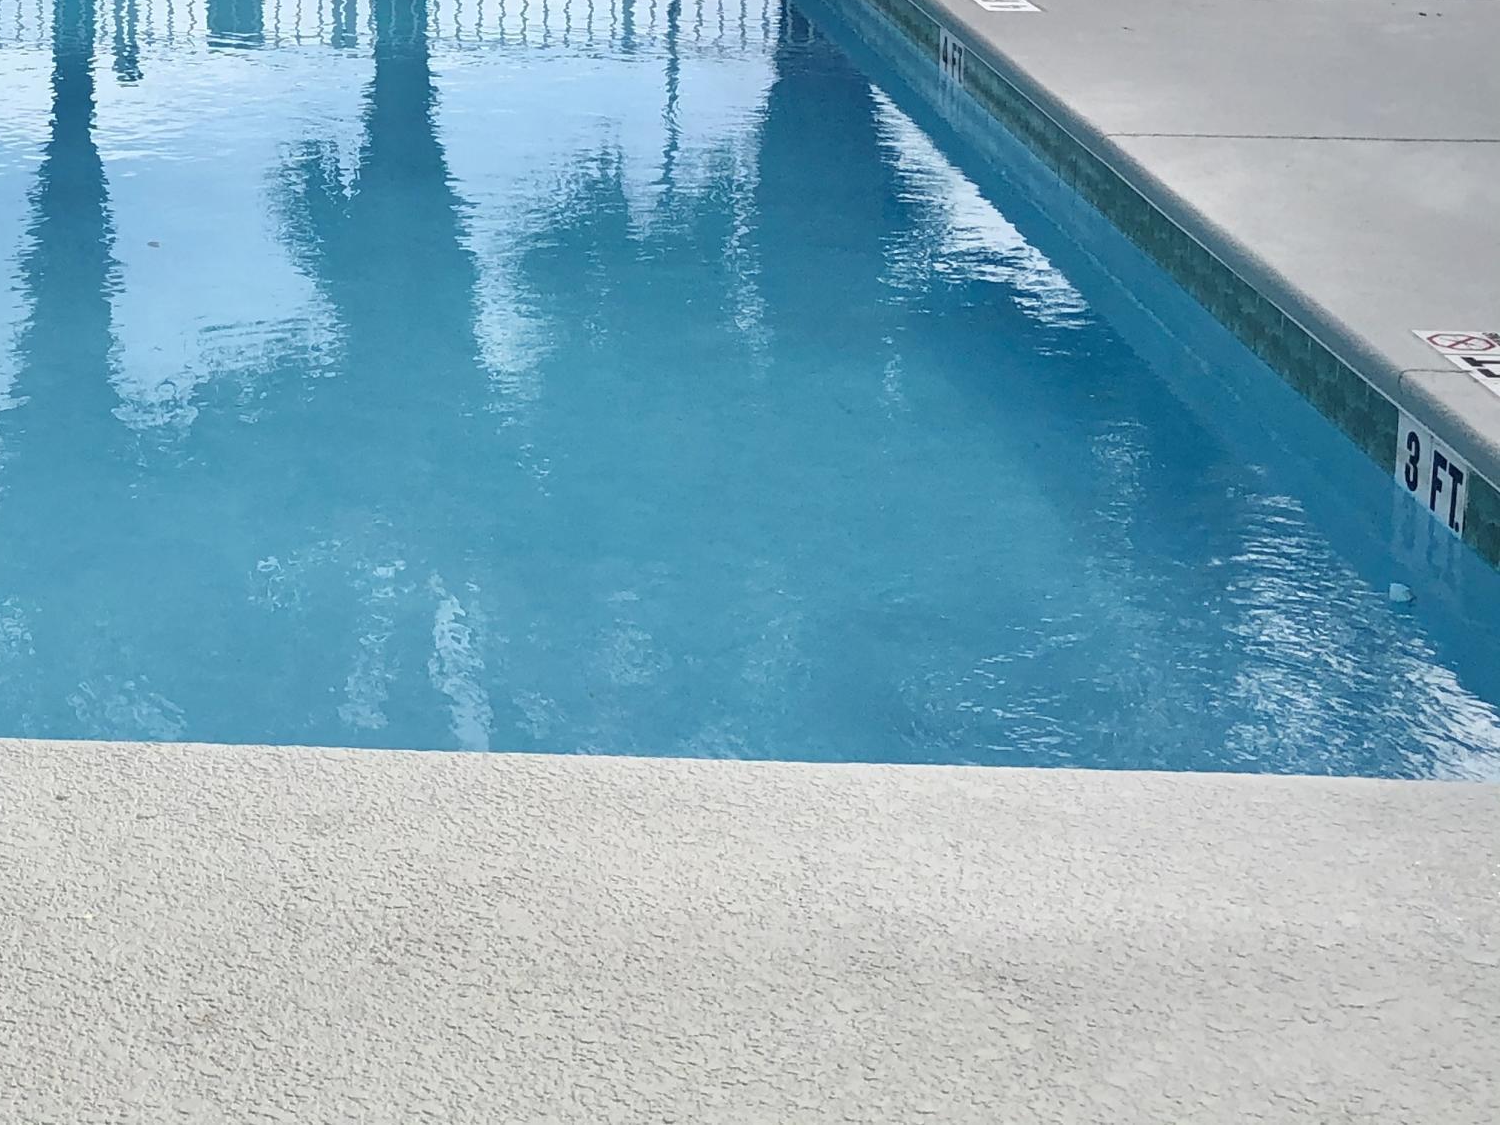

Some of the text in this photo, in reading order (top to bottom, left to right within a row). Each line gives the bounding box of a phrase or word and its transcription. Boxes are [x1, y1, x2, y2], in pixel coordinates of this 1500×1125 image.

[942, 35, 948, 73] 4
[1404, 431, 1464, 533] 3 FT.
